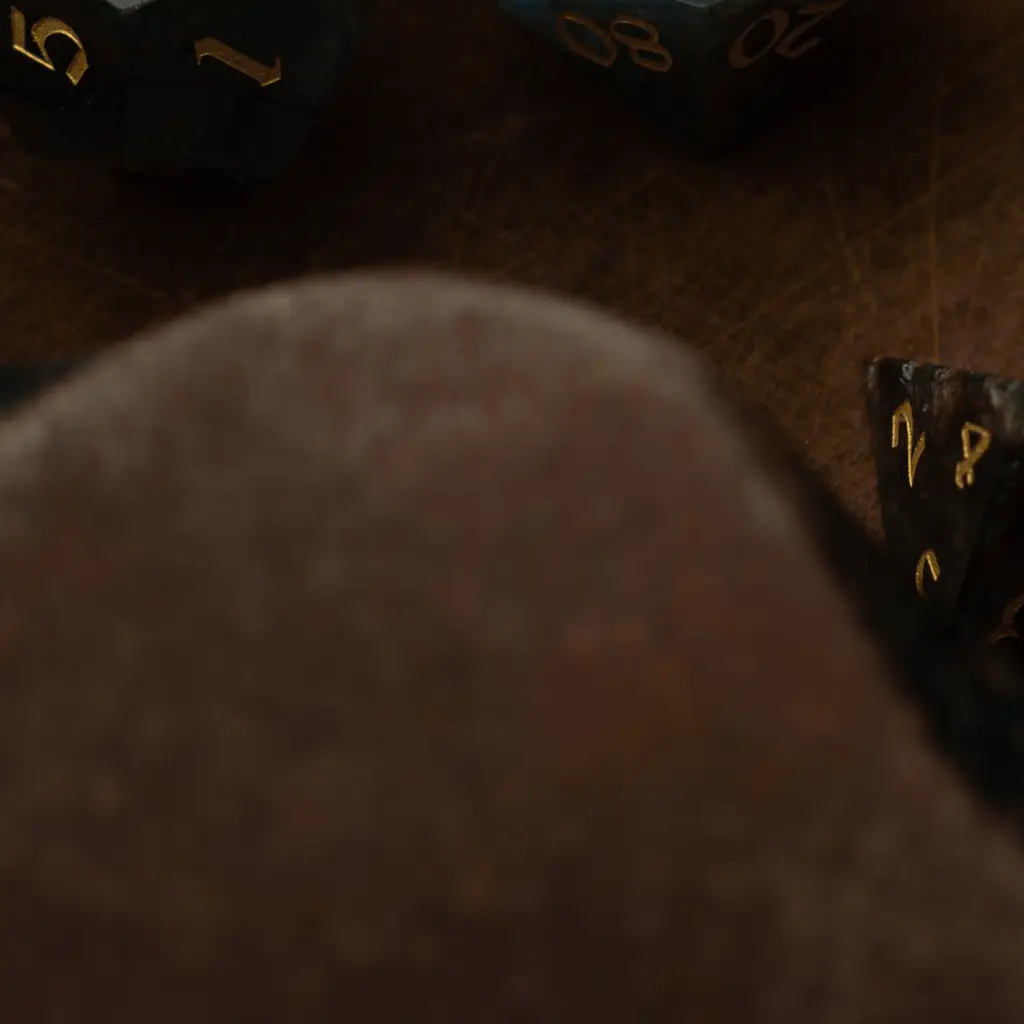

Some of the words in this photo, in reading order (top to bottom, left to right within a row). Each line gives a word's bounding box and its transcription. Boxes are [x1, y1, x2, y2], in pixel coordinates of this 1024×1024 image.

[9, 4, 90, 88] 5
[194, 36, 283, 88] 1
[892, 399, 928, 488] 2
